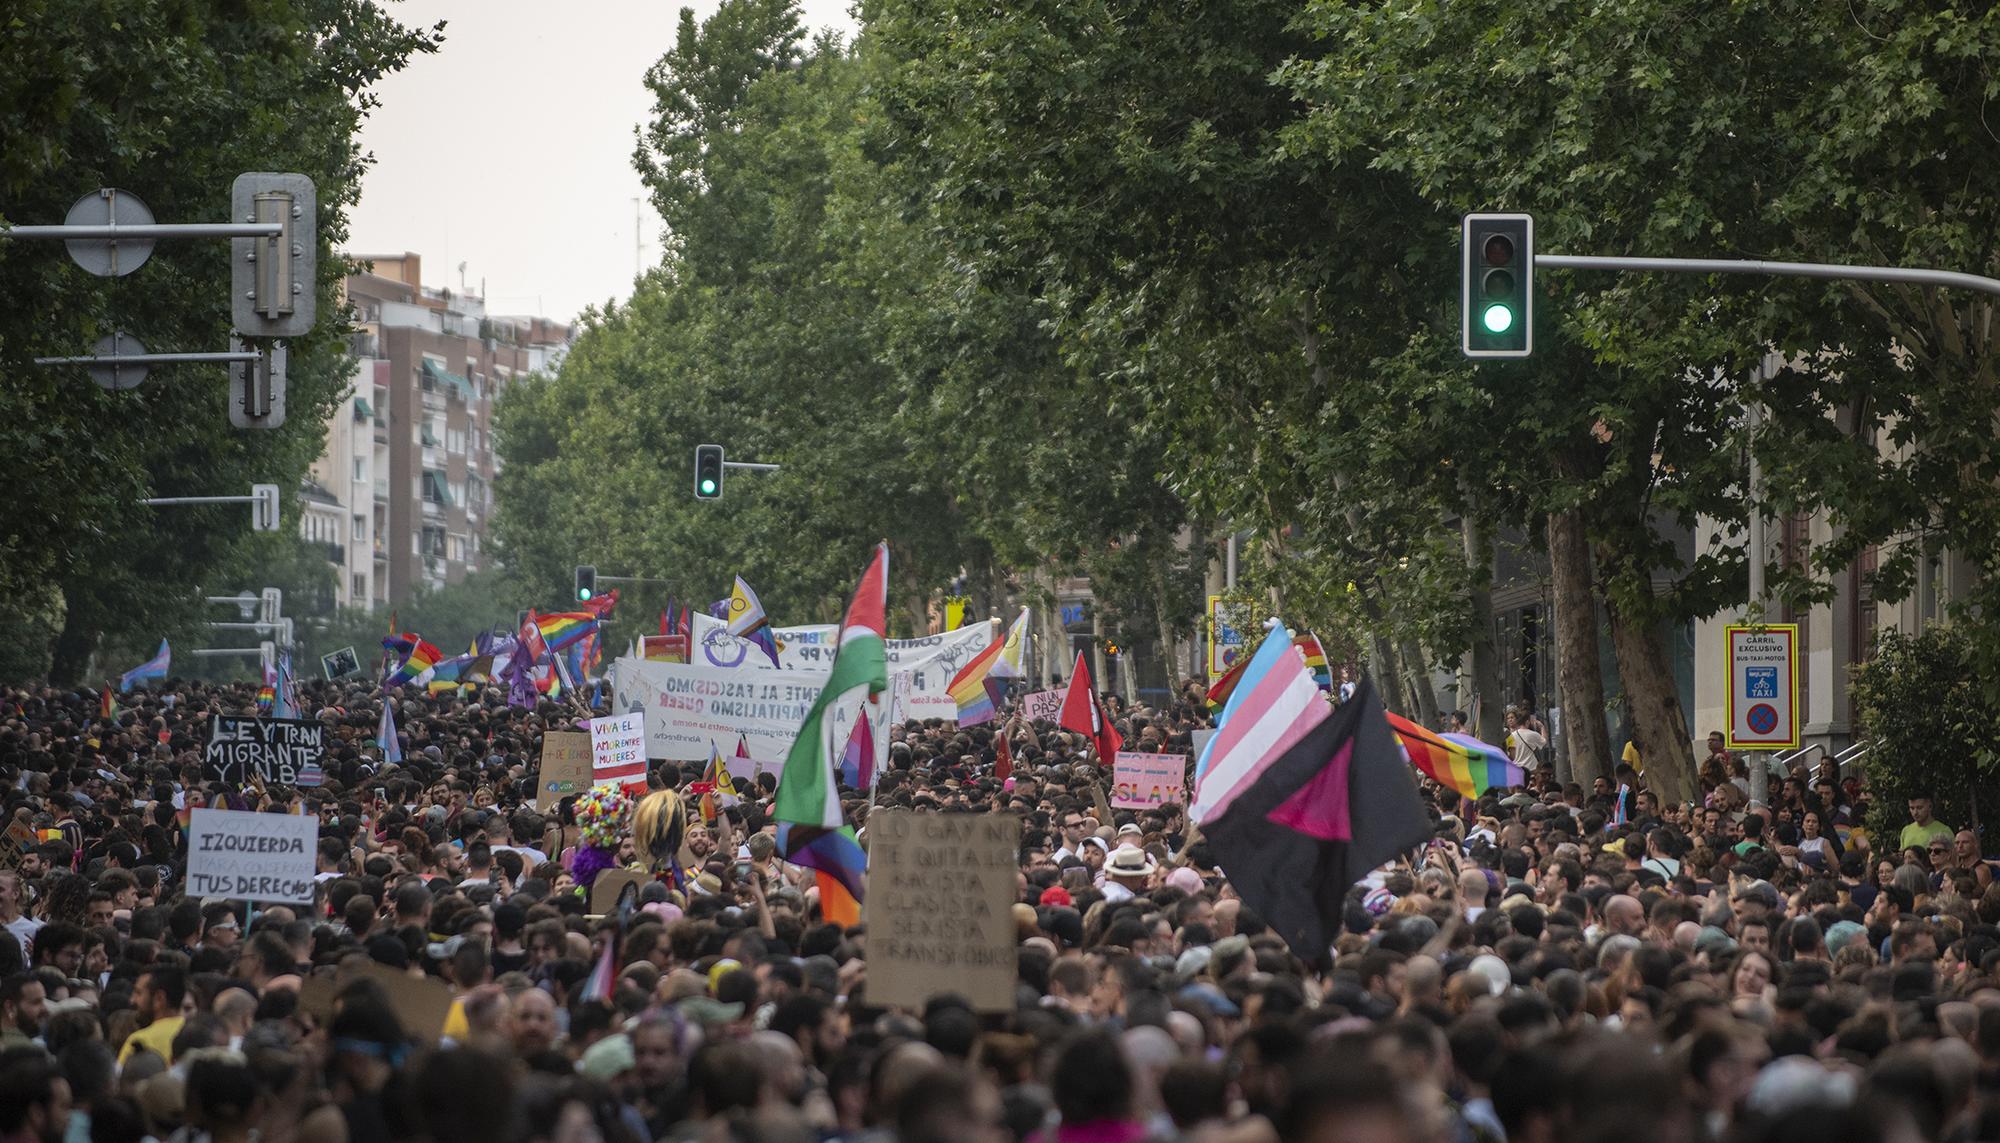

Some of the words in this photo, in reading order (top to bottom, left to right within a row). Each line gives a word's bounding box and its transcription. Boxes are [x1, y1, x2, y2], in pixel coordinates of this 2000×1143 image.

[1746, 636, 1775, 644] CARRIL
[1751, 689, 1773, 697] TAXI
[595, 722, 619, 735] VIVA
[622, 720, 633, 731] EL
[595, 740, 620, 751] AMOR
[621, 737, 640, 747] ENTRE
[599, 750, 636, 764] MUJERES
[1116, 783, 1179, 803] SLAY
[922, 817, 976, 842] GAY
[199, 833, 304, 853] IZQUIERDA
[193, 873, 233, 893] TUS
[236, 875, 314, 900] DERECHOS
